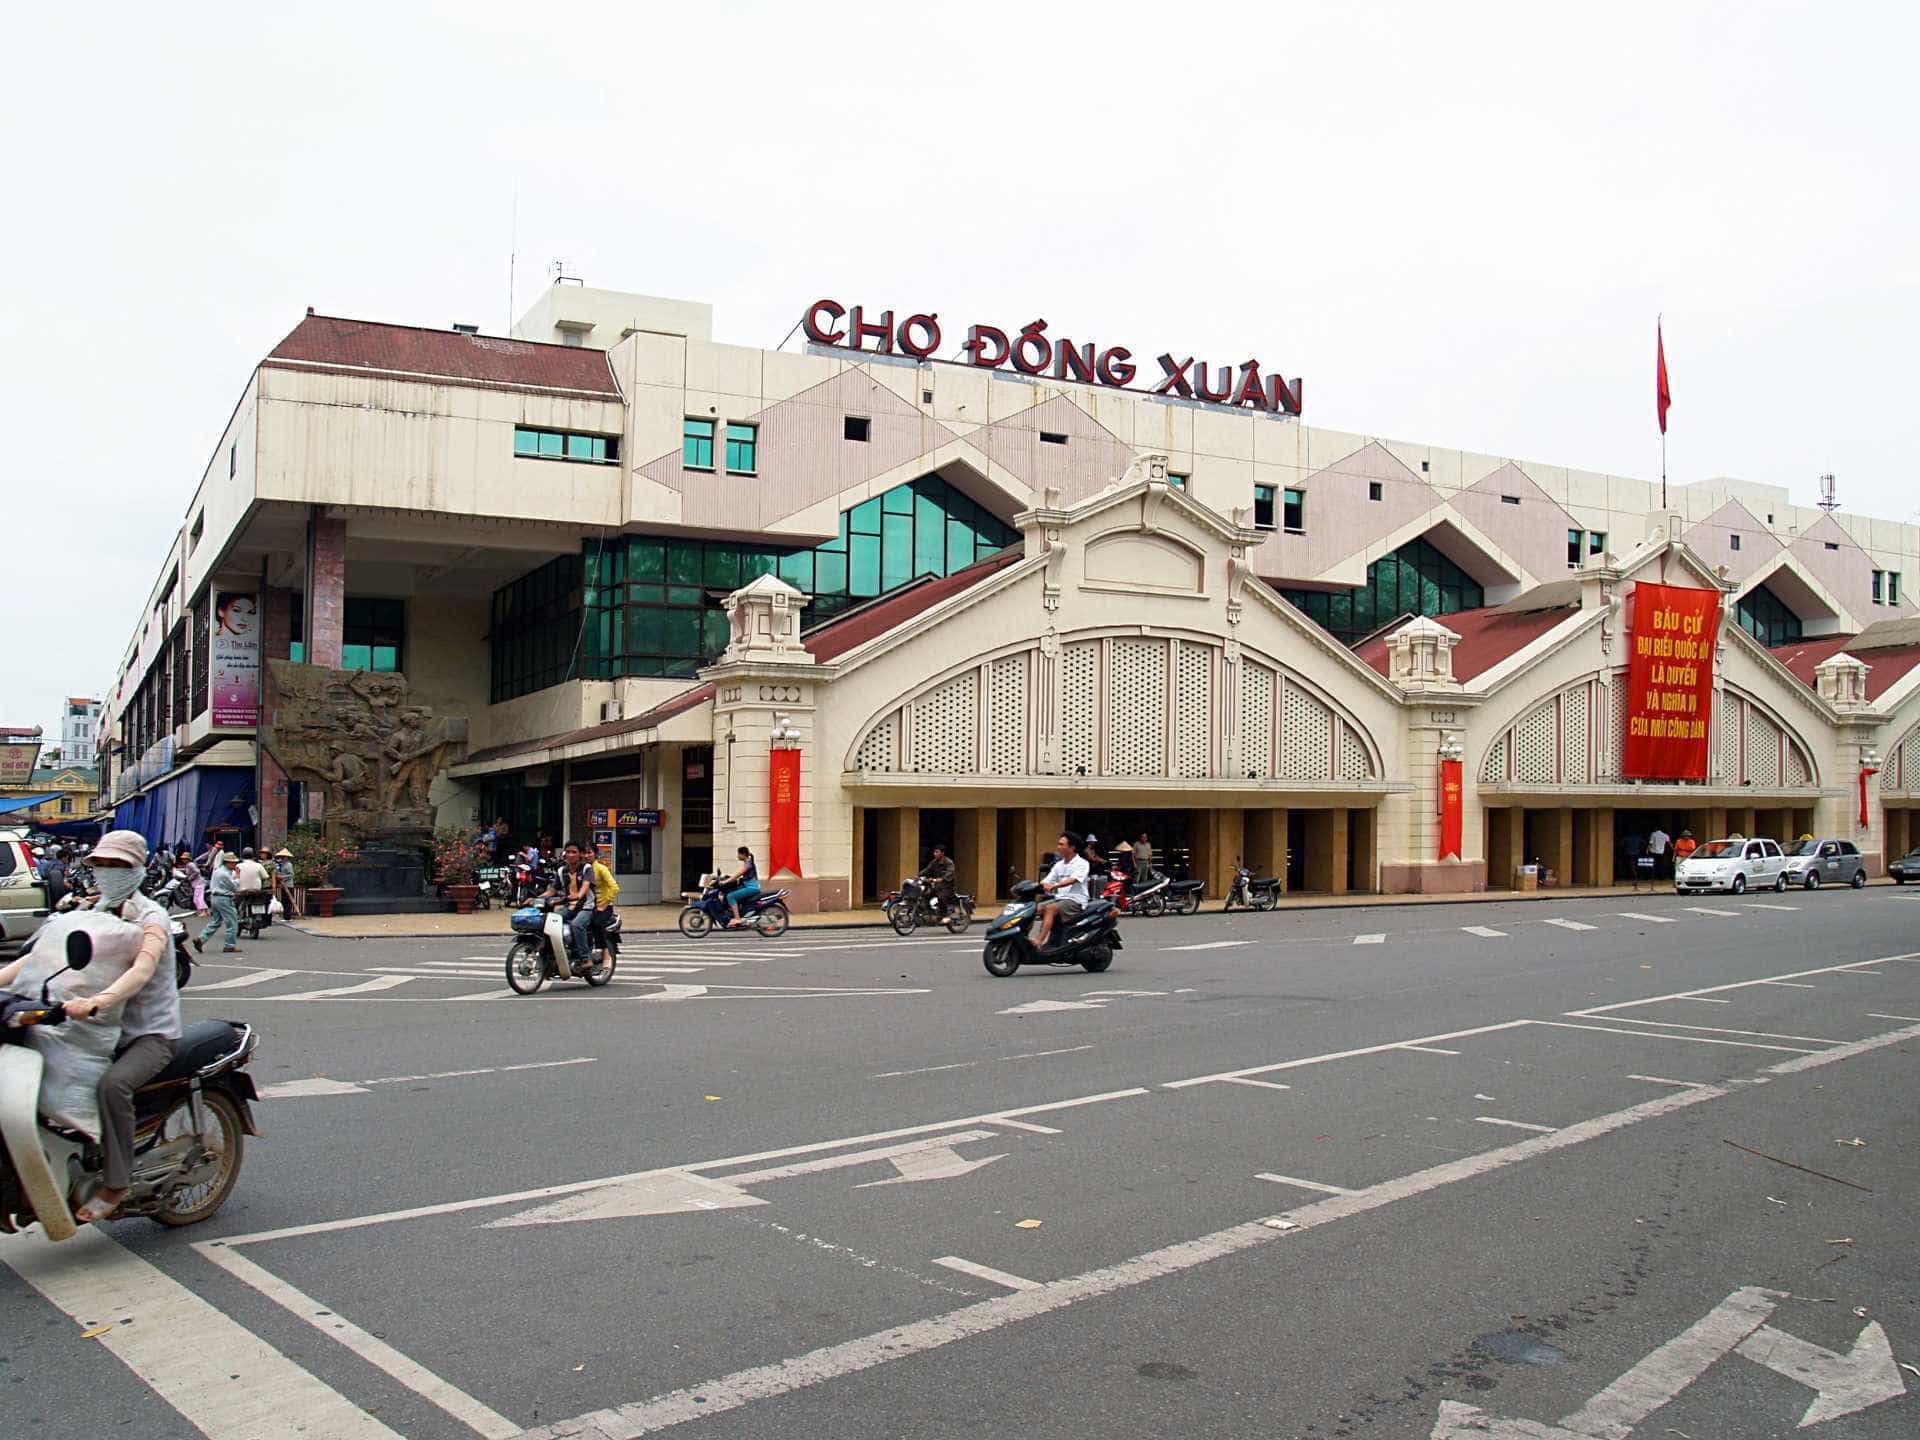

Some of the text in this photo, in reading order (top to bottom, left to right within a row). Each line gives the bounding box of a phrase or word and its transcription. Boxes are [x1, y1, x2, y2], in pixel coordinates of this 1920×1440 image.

[803, 299, 941, 363] CHỢ
[1158, 352, 1302, 416] XUÂN
[1653, 605, 1704, 634] BẦU CỬ
[1637, 635, 1652, 659] ĐẠI
[1674, 634, 1697, 660] QUỐC
[1651, 661, 1665, 684] LÀ
[1646, 688, 1659, 710] VÀ
[1630, 711, 1648, 737] CỦA
